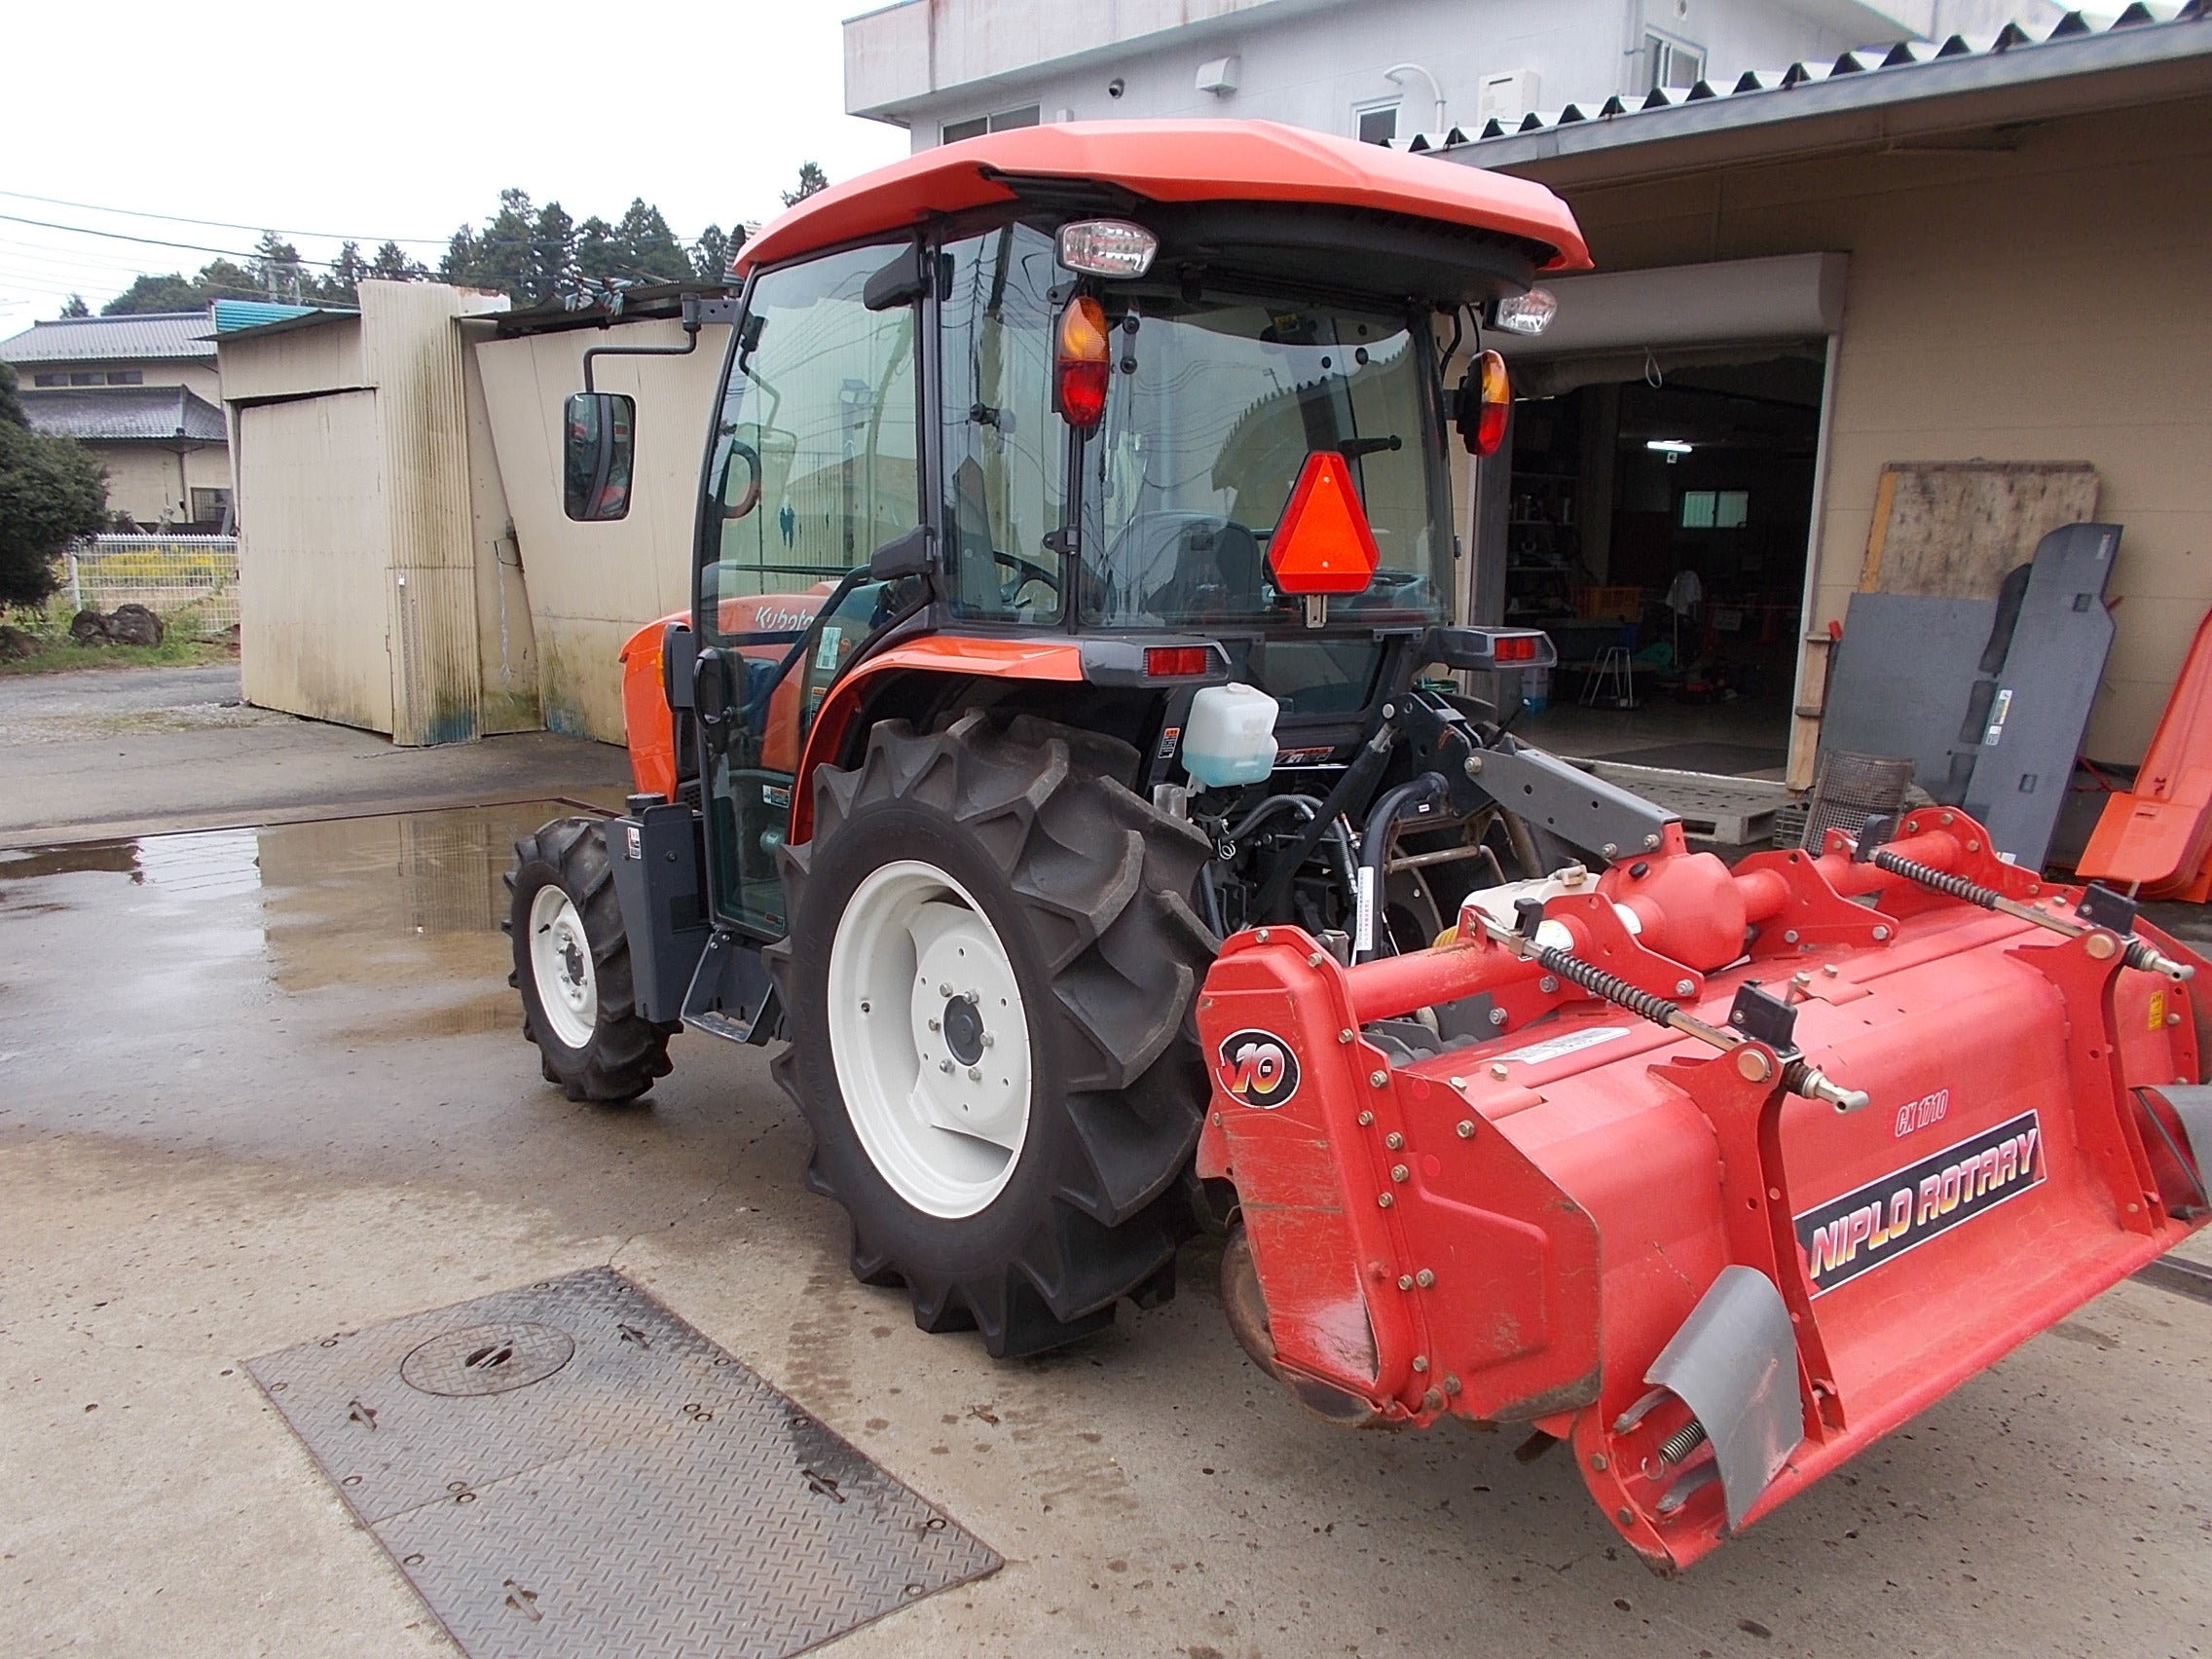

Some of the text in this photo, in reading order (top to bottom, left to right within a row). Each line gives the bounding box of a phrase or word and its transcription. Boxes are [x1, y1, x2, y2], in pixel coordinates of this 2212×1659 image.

[756, 606, 815, 631] Kubota
[1232, 1043, 1285, 1093] 10
[1917, 1089, 1949, 1128] 1710
[1810, 1127, 2038, 1280] NIPLO ROTARY
